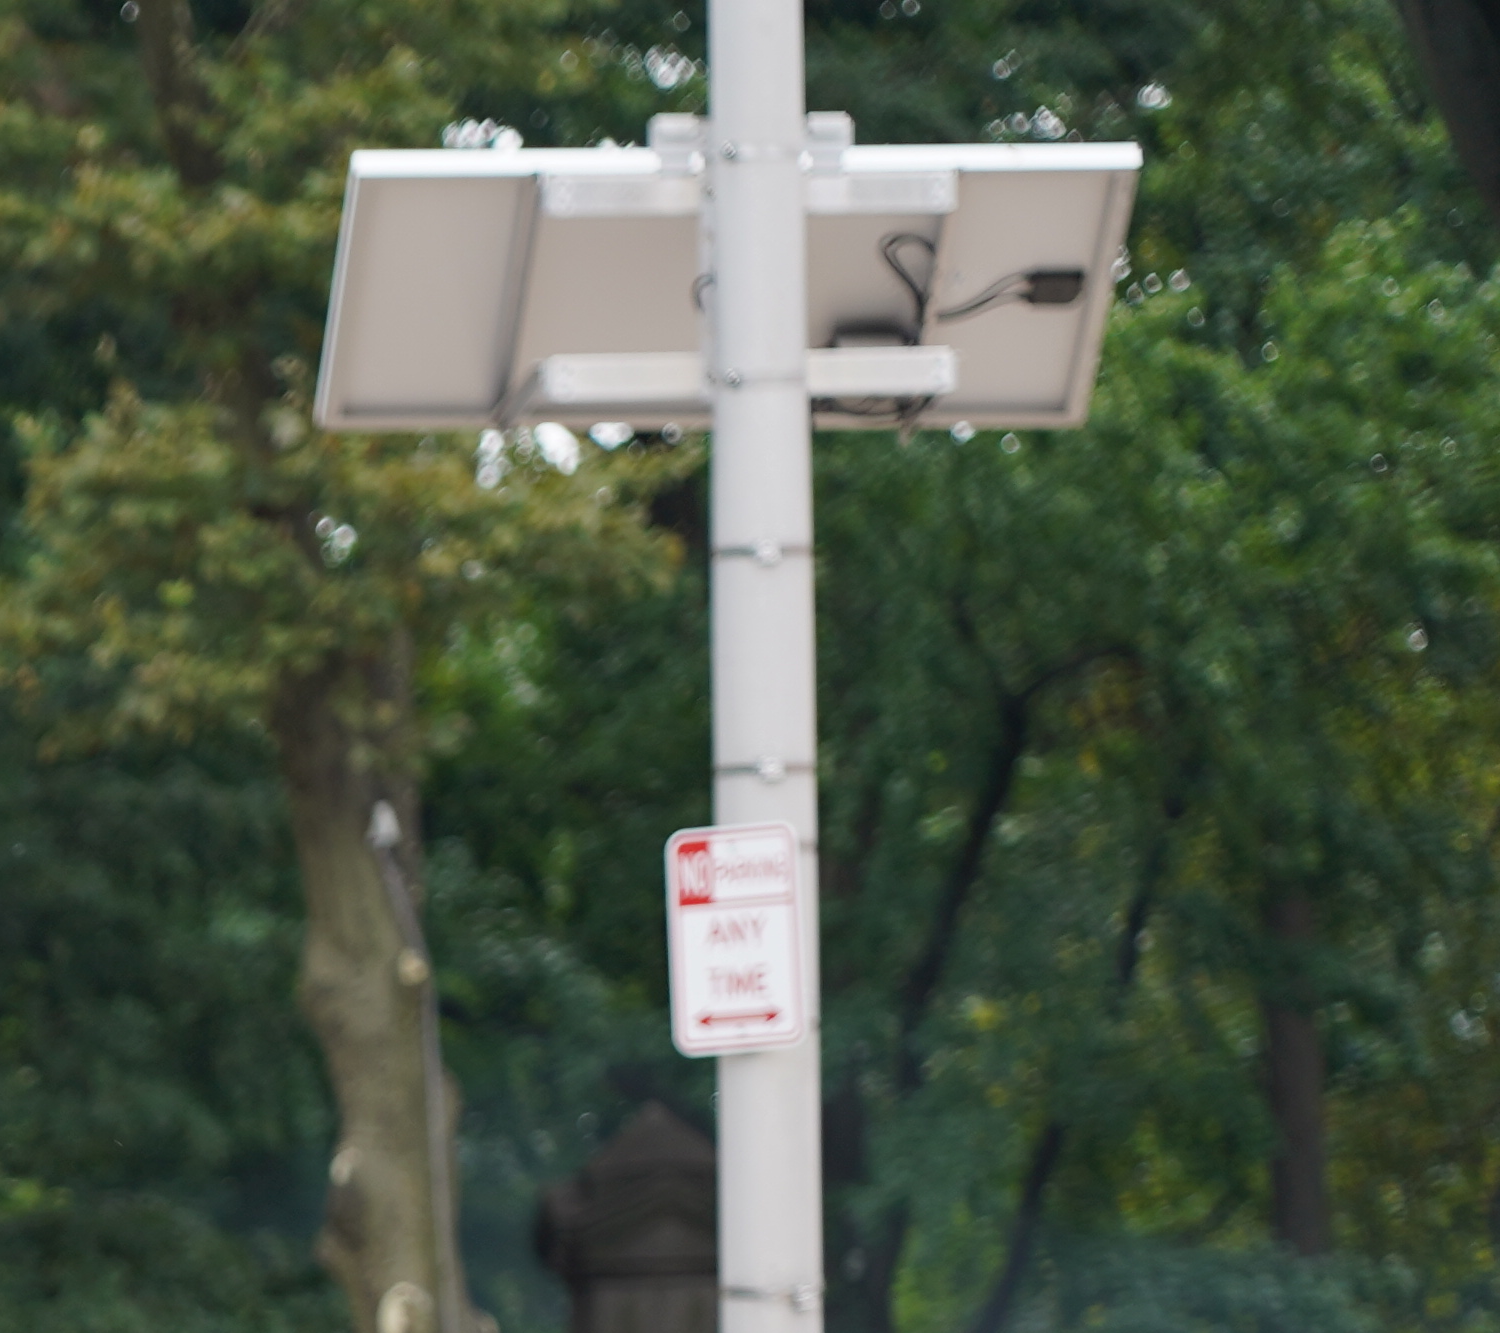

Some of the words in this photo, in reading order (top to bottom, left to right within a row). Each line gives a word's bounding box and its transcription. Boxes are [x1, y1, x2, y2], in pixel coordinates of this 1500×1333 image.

[679, 852, 710, 897] NO
[707, 912, 767, 944] ANY
[708, 964, 770, 998] TIME
